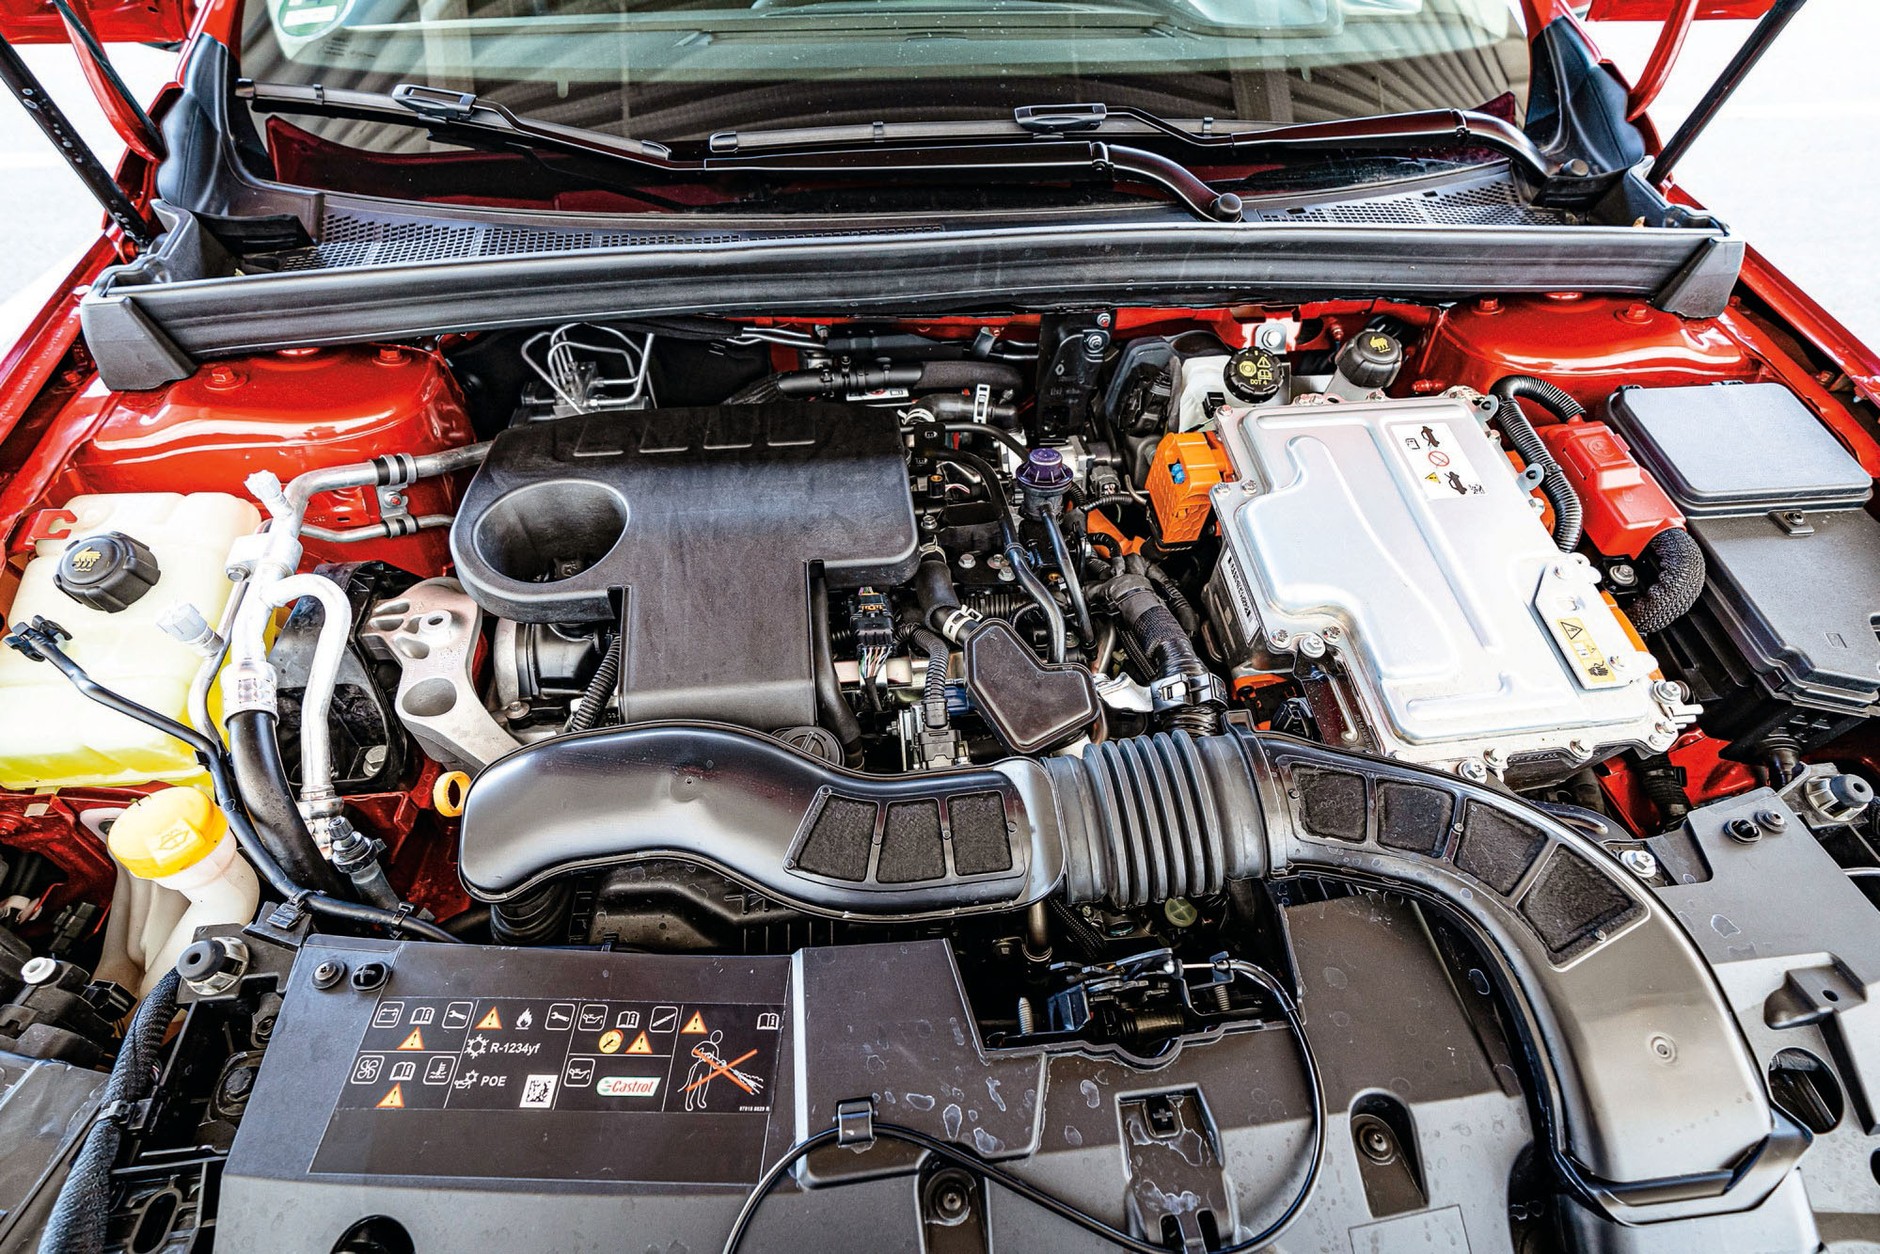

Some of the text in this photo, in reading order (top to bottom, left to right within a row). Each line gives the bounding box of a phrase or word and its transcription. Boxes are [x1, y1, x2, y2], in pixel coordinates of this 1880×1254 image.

[489, 1042, 541, 1056] R-1234yf
[480, 1075, 507, 1087] POE
[611, 1080, 654, 1093] Castrol
